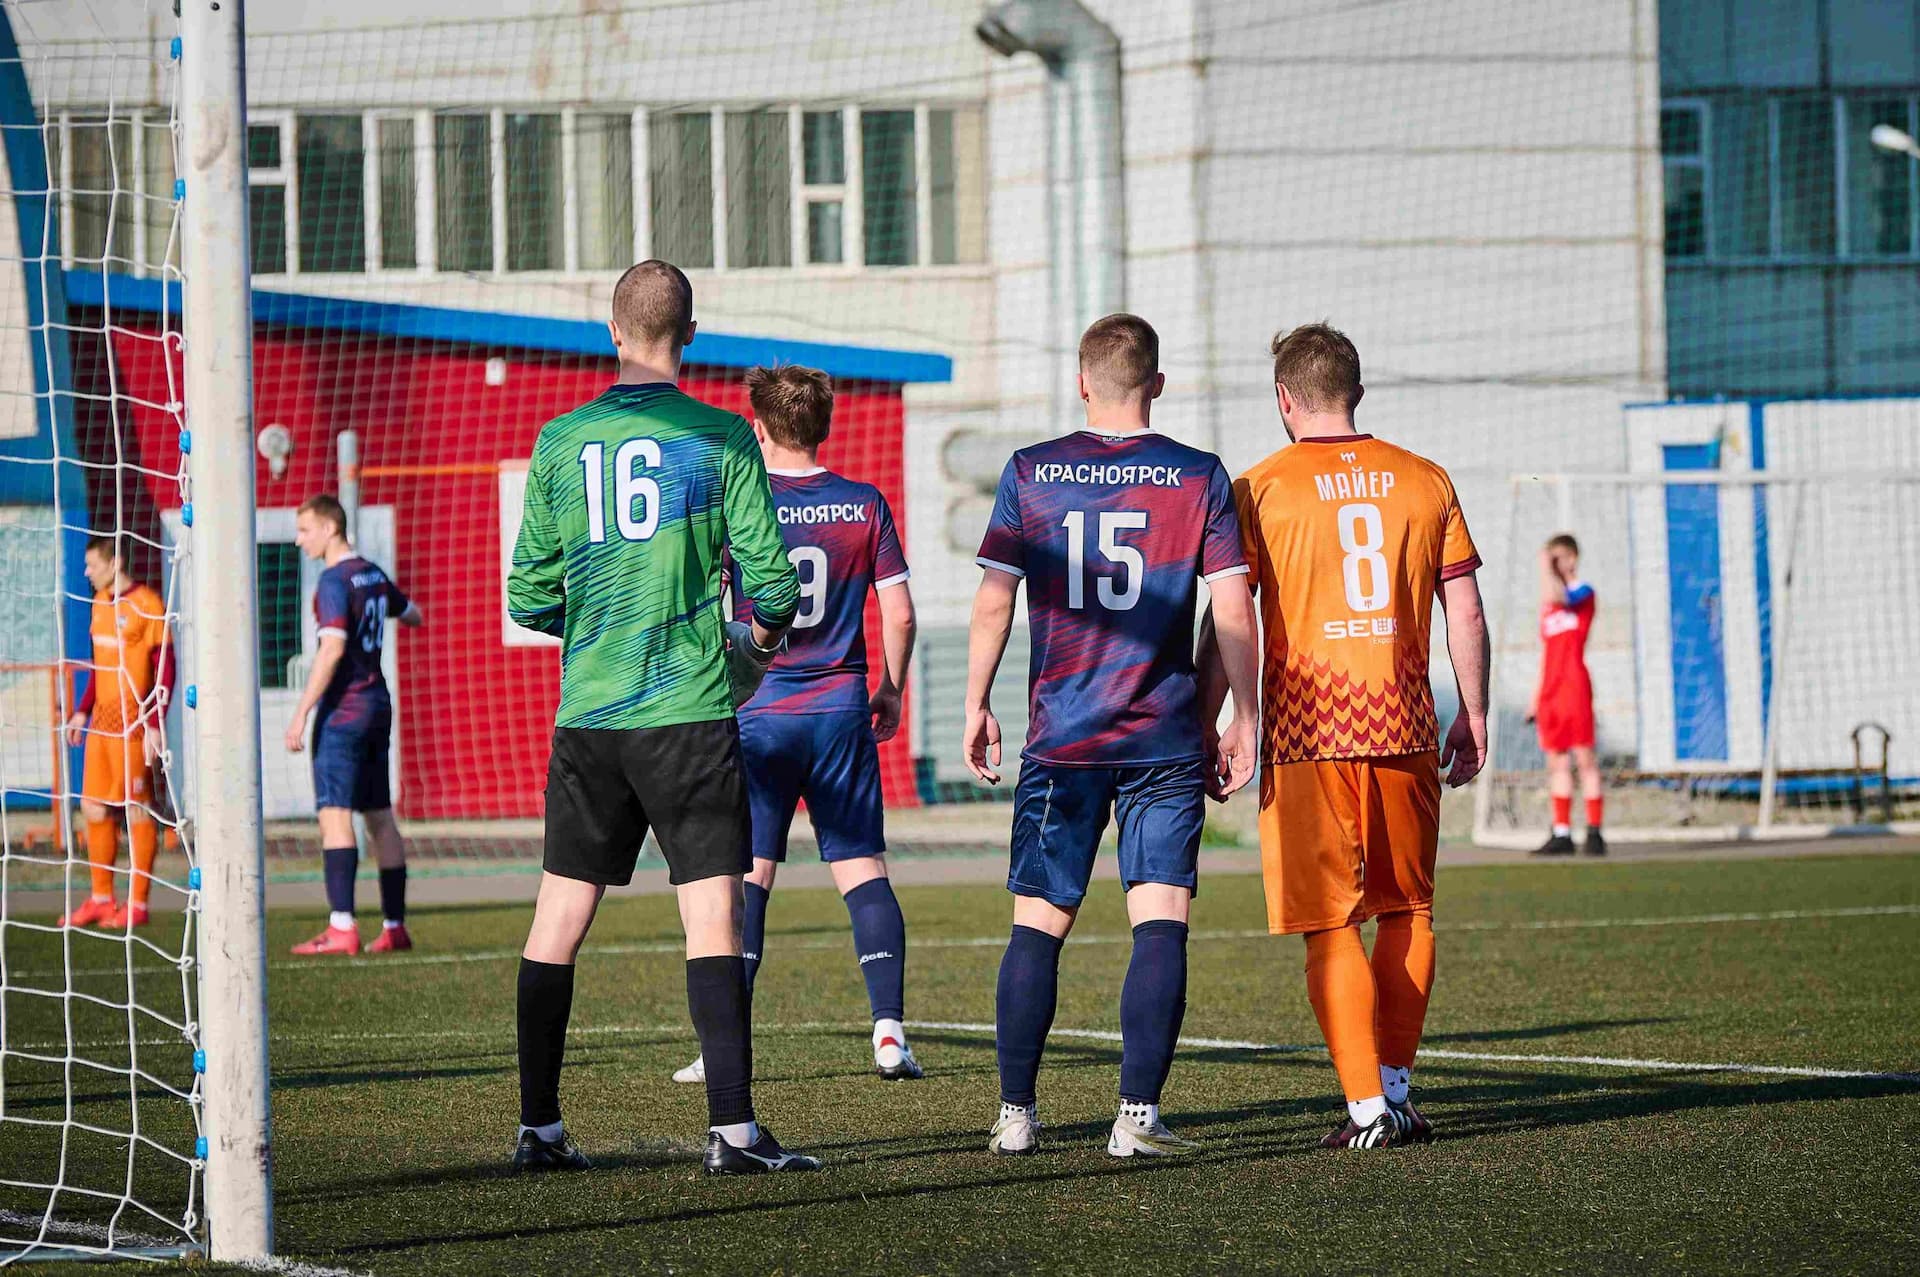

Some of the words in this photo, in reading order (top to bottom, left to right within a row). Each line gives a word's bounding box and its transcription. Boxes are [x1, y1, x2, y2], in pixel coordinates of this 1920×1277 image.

[579, 437, 662, 543] 16
[1035, 463, 1181, 487] КРАСНОЯРСК
[1314, 467, 1396, 501] МАЙЕР
[788, 546, 828, 629] 9
[1062, 510, 1147, 611] 15
[1337, 503, 1390, 612] 8
